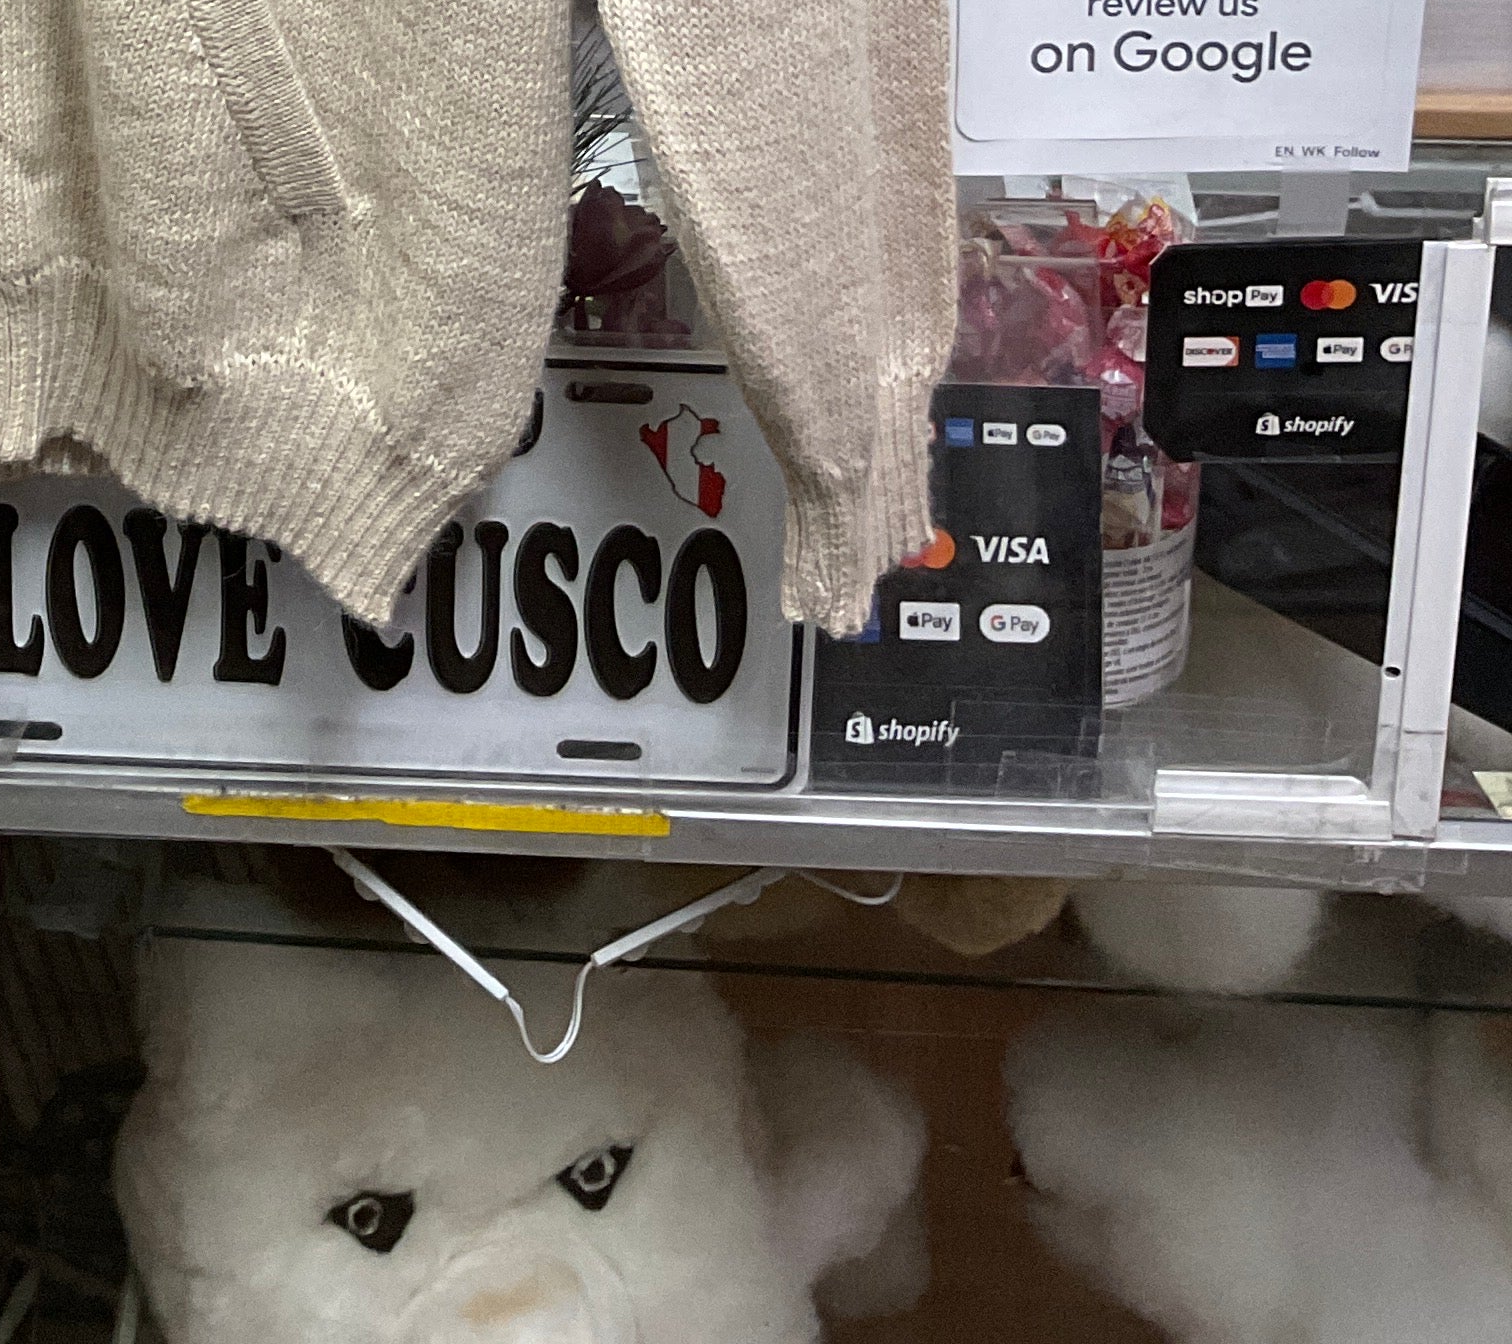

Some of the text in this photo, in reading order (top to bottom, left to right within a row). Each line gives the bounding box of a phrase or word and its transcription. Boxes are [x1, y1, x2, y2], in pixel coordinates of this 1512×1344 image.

[1030, 30, 1313, 84] on Google
[1334, 145, 1381, 159] Follow
[1183, 282, 1419, 308] shop Pay VIS
[1333, 344, 1358, 356] Pay
[994, 428, 1013, 441] Pay
[1042, 430, 1061, 442] Pay
[1283, 416, 1354, 436] shopify
[969, 535, 1050, 565] VISA
[921, 613, 1040, 635] Pay G Pay
[878, 720, 961, 747] shopify
